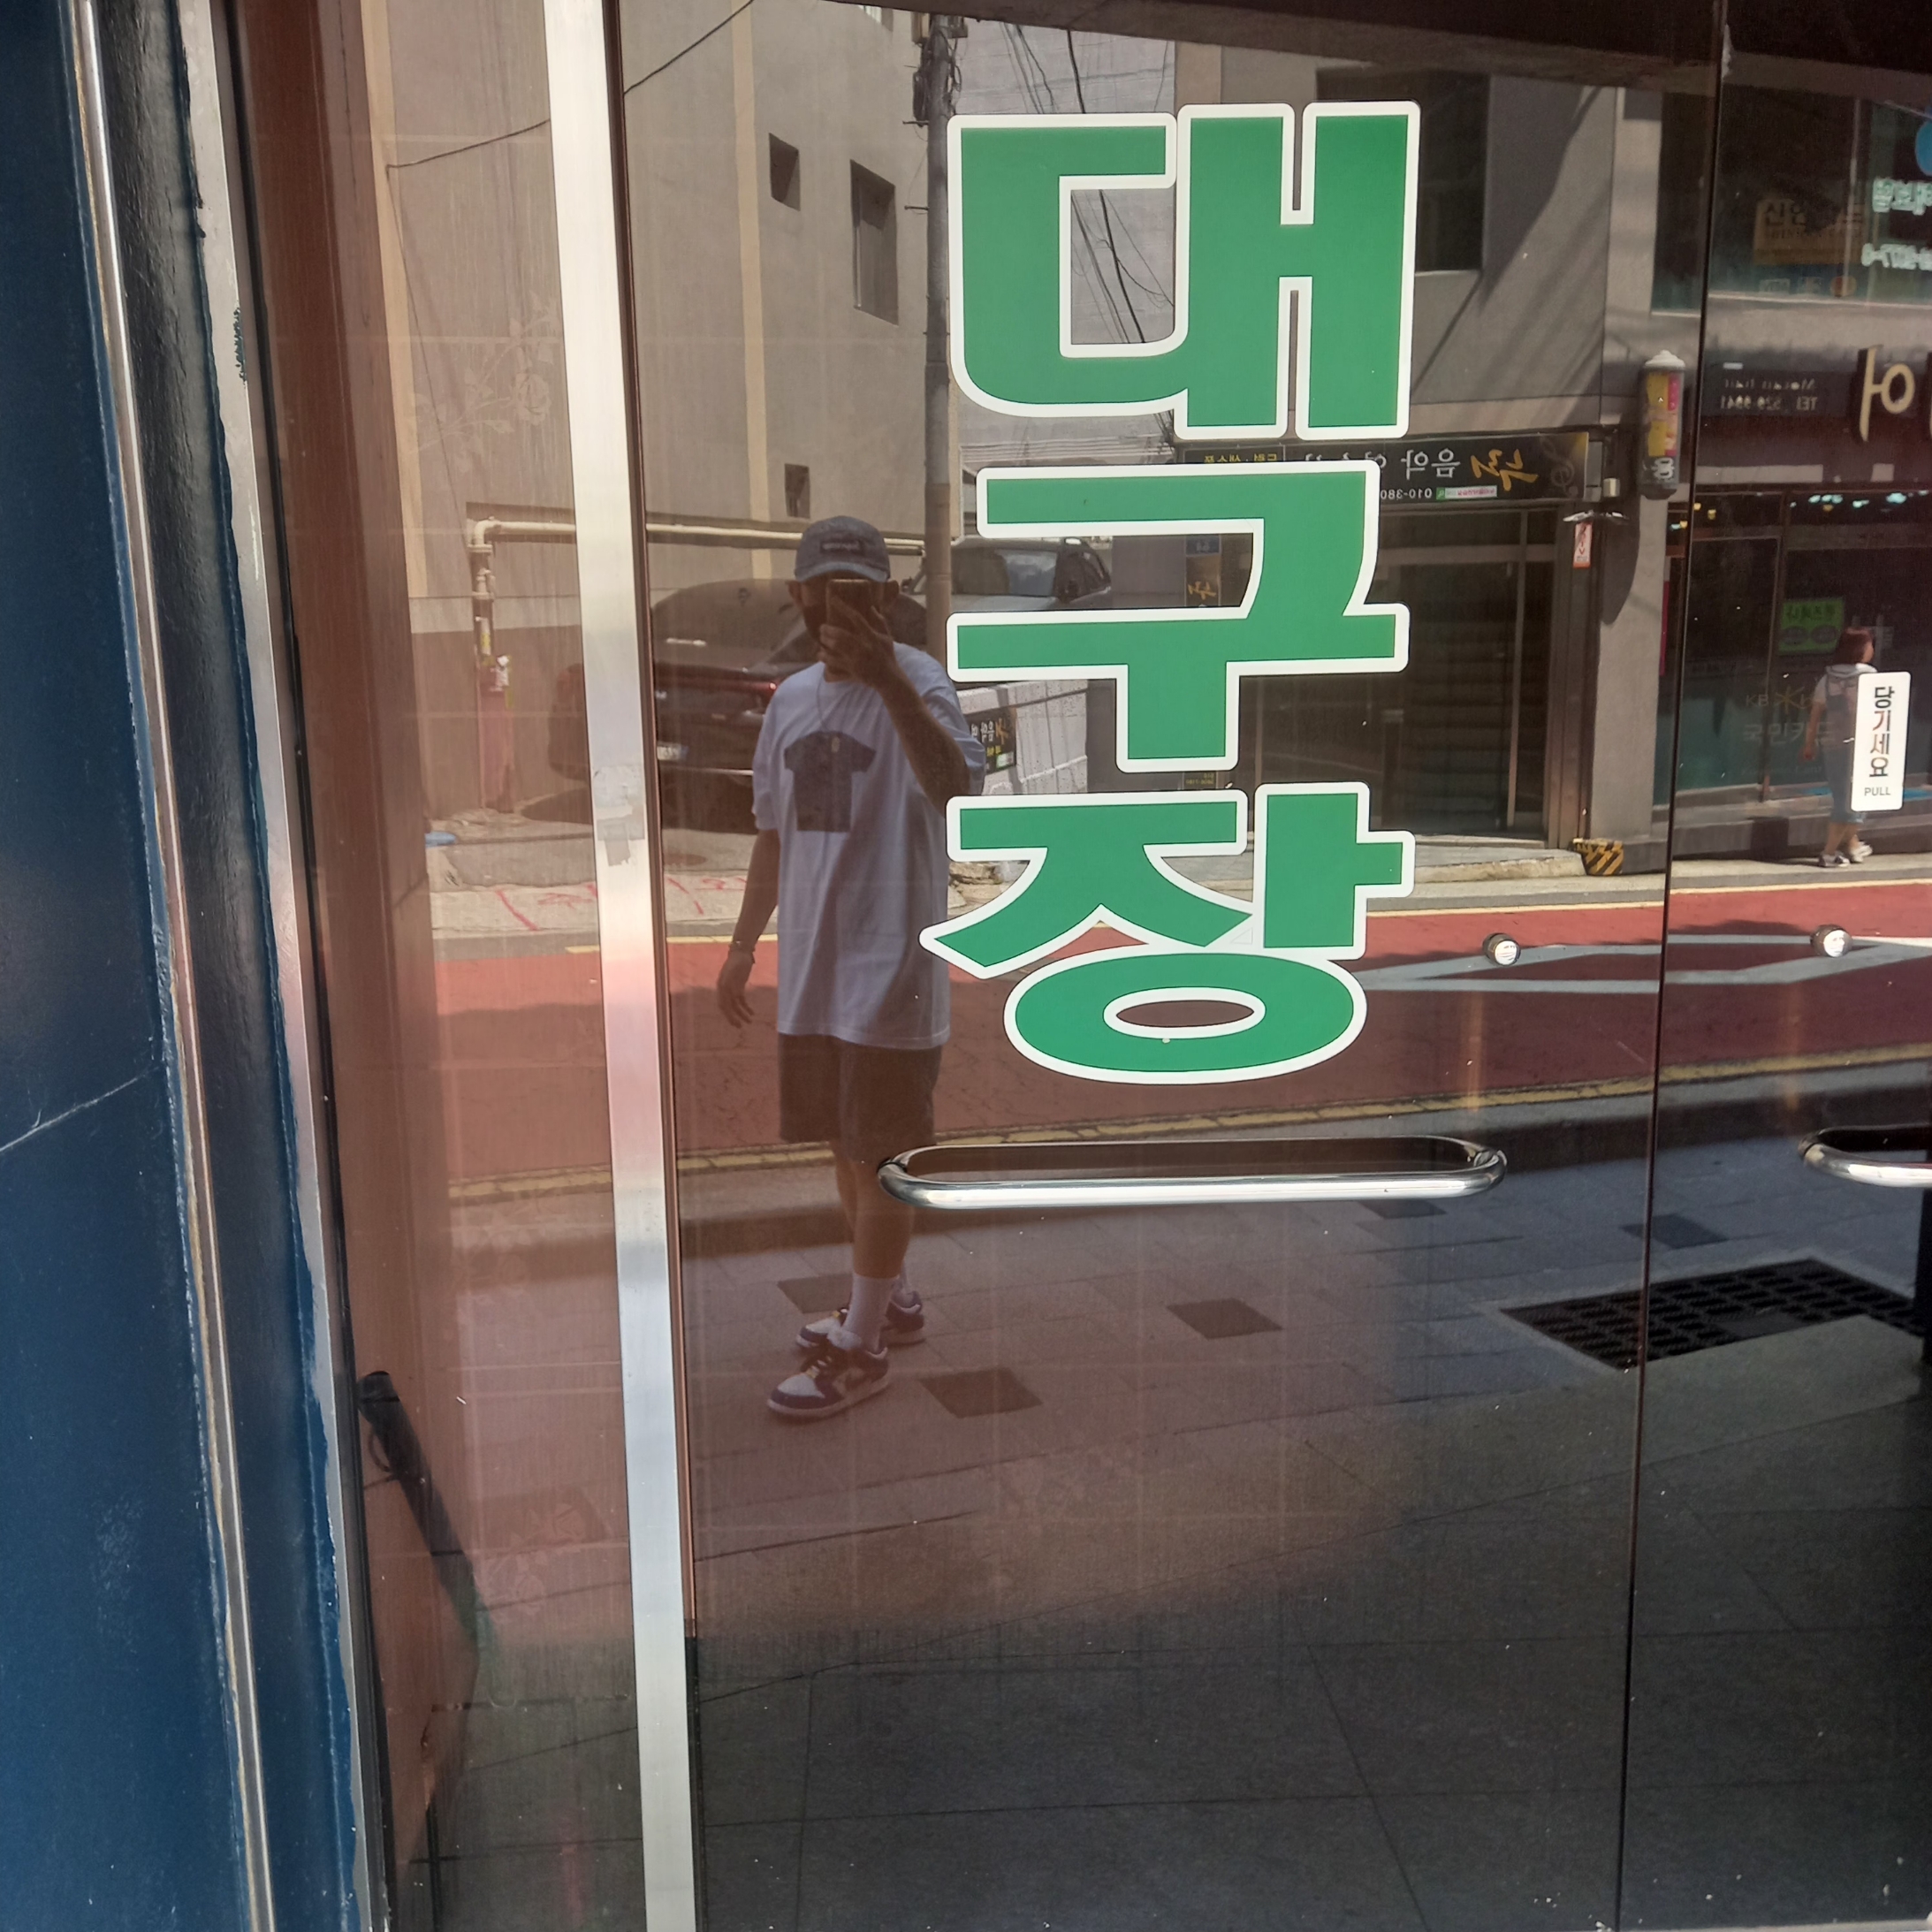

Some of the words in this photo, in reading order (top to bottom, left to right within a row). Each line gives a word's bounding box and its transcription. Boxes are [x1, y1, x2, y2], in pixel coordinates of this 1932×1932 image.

[920, 101, 1420, 1084] 대구장
[1869, 686, 1895, 778] 당기세요
[1864, 787, 1891, 796] PULL
